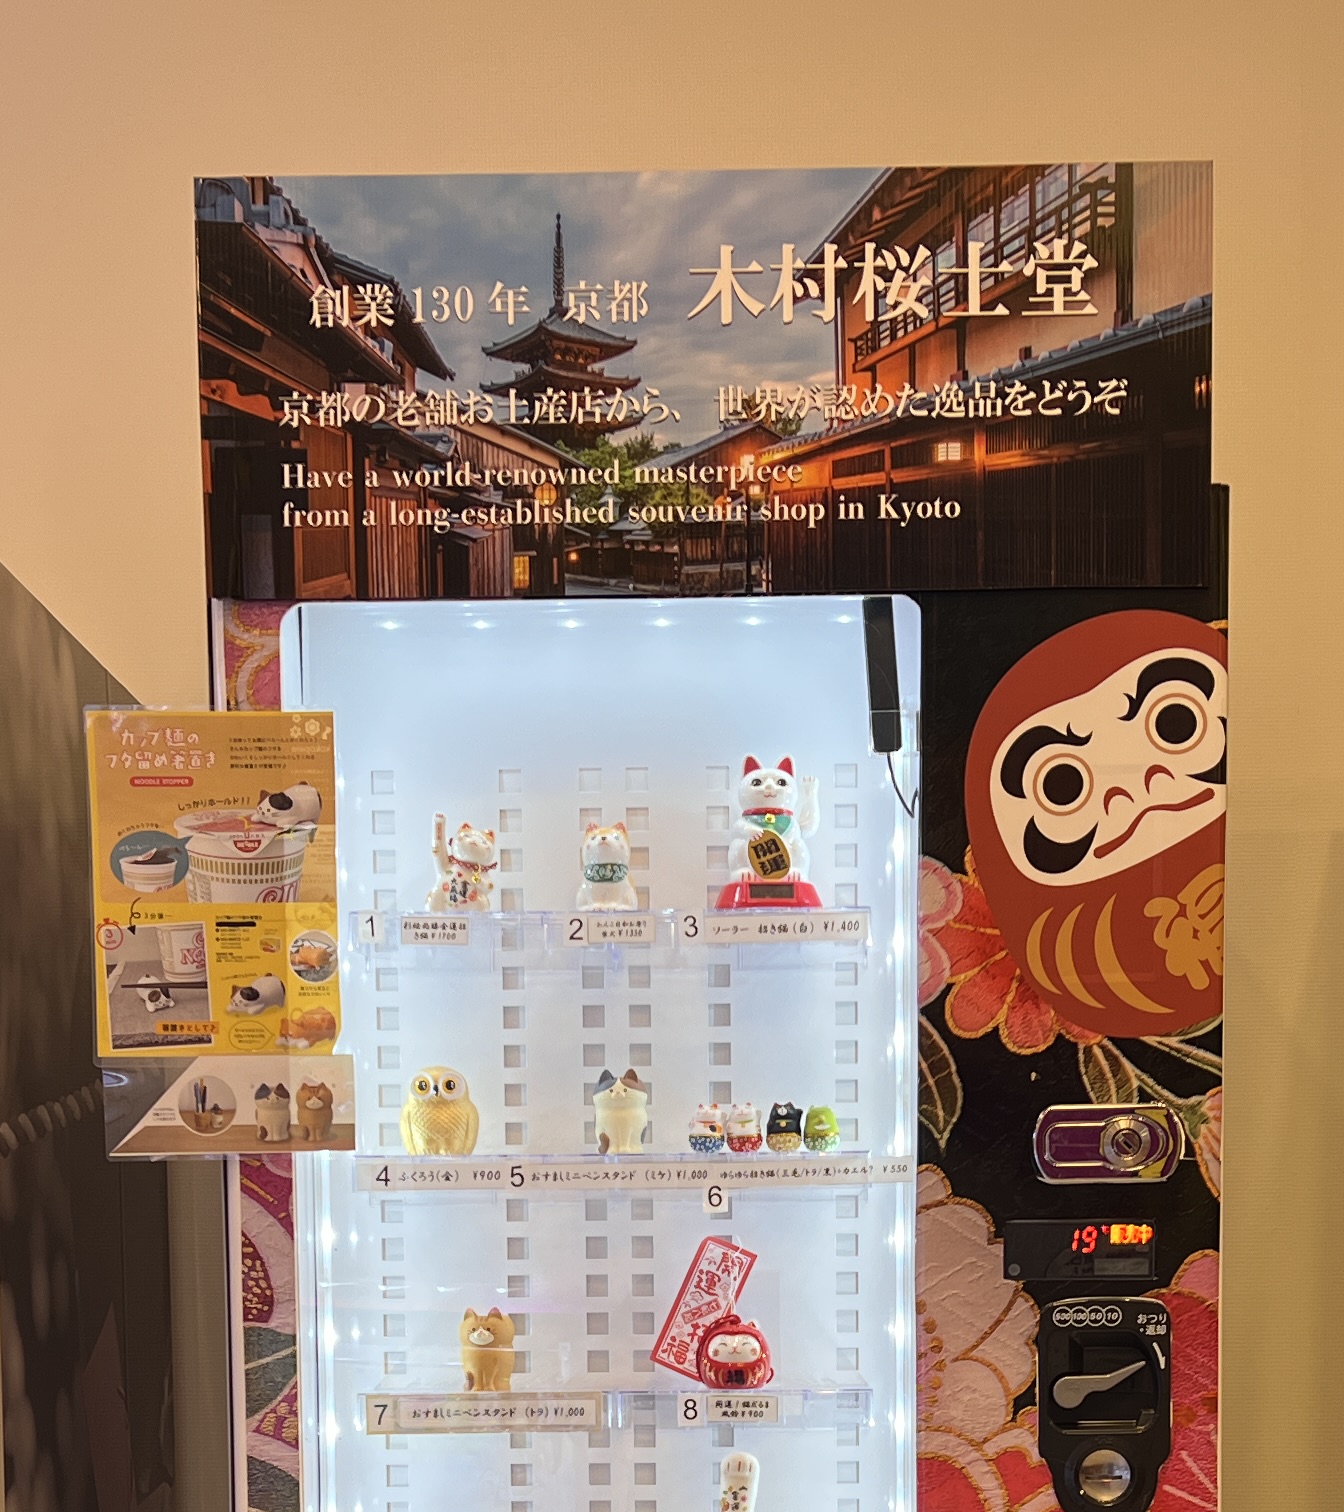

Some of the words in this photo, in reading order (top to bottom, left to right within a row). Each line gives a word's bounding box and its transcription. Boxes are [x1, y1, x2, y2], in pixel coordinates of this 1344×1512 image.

[309, 286, 395, 329] 創業
[410, 287, 476, 324] 130
[488, 281, 531, 325] 年
[560, 281, 649, 324] 京都
[687, 239, 1101, 324] 木村桜士堂
[278, 388, 682, 428] 京都の老舗お土産店から、
[714, 380, 1129, 421] 世界が認めた逸品をどうぞ
[281, 463, 354, 489] Have
[365, 471, 382, 487] a
[391, 461, 620, 488] world-renowned
[634, 458, 802, 490] masterpiece
[281, 501, 350, 528] from
[362, 507, 378, 526] a
[388, 495, 615, 532] long-established
[627, 497, 749, 523] souvenir
[759, 495, 826, 526] shop
[837, 495, 866, 519] in
[876, 494, 962, 526] Kyoto
[121, 728, 199, 746] カップ麺の
[106, 751, 216, 770] フタ留め箸置き
[365, 915, 375, 937] 1
[569, 919, 584, 940] 2
[684, 916, 698, 938] 3
[376, 1165, 391, 1187] 4
[473, 1170, 501, 1181] ¥900
[510, 1165, 525, 1187] 5
[708, 1186, 722, 1207] 6
[1071, 1225, 1098, 1254] 19
[374, 1404, 388, 1425] 7
[683, 1399, 698, 1420] 8
